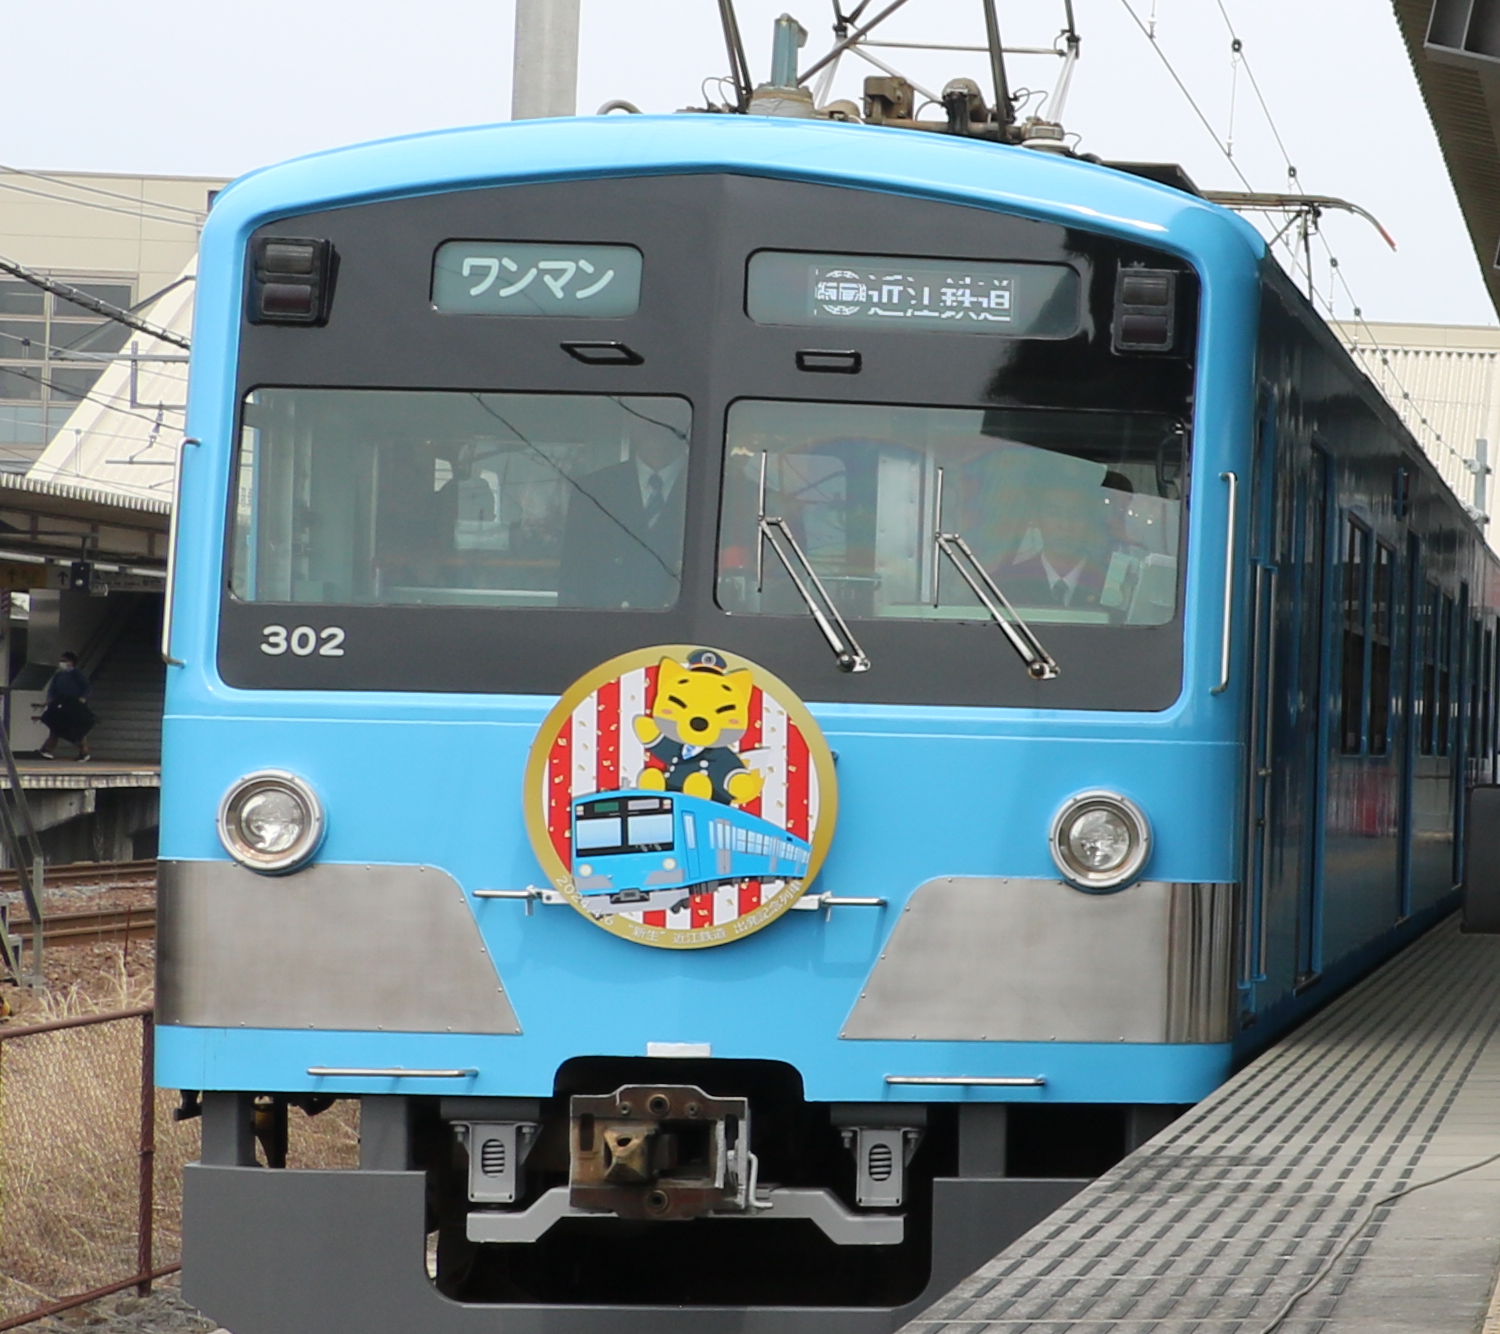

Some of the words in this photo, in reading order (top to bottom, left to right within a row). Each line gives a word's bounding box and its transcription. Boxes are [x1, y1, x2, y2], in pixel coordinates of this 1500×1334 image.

[462, 257, 614, 299] ワンマン
[260, 625, 345, 657] 302
[671, 928, 727, 945] 近江鉄道
